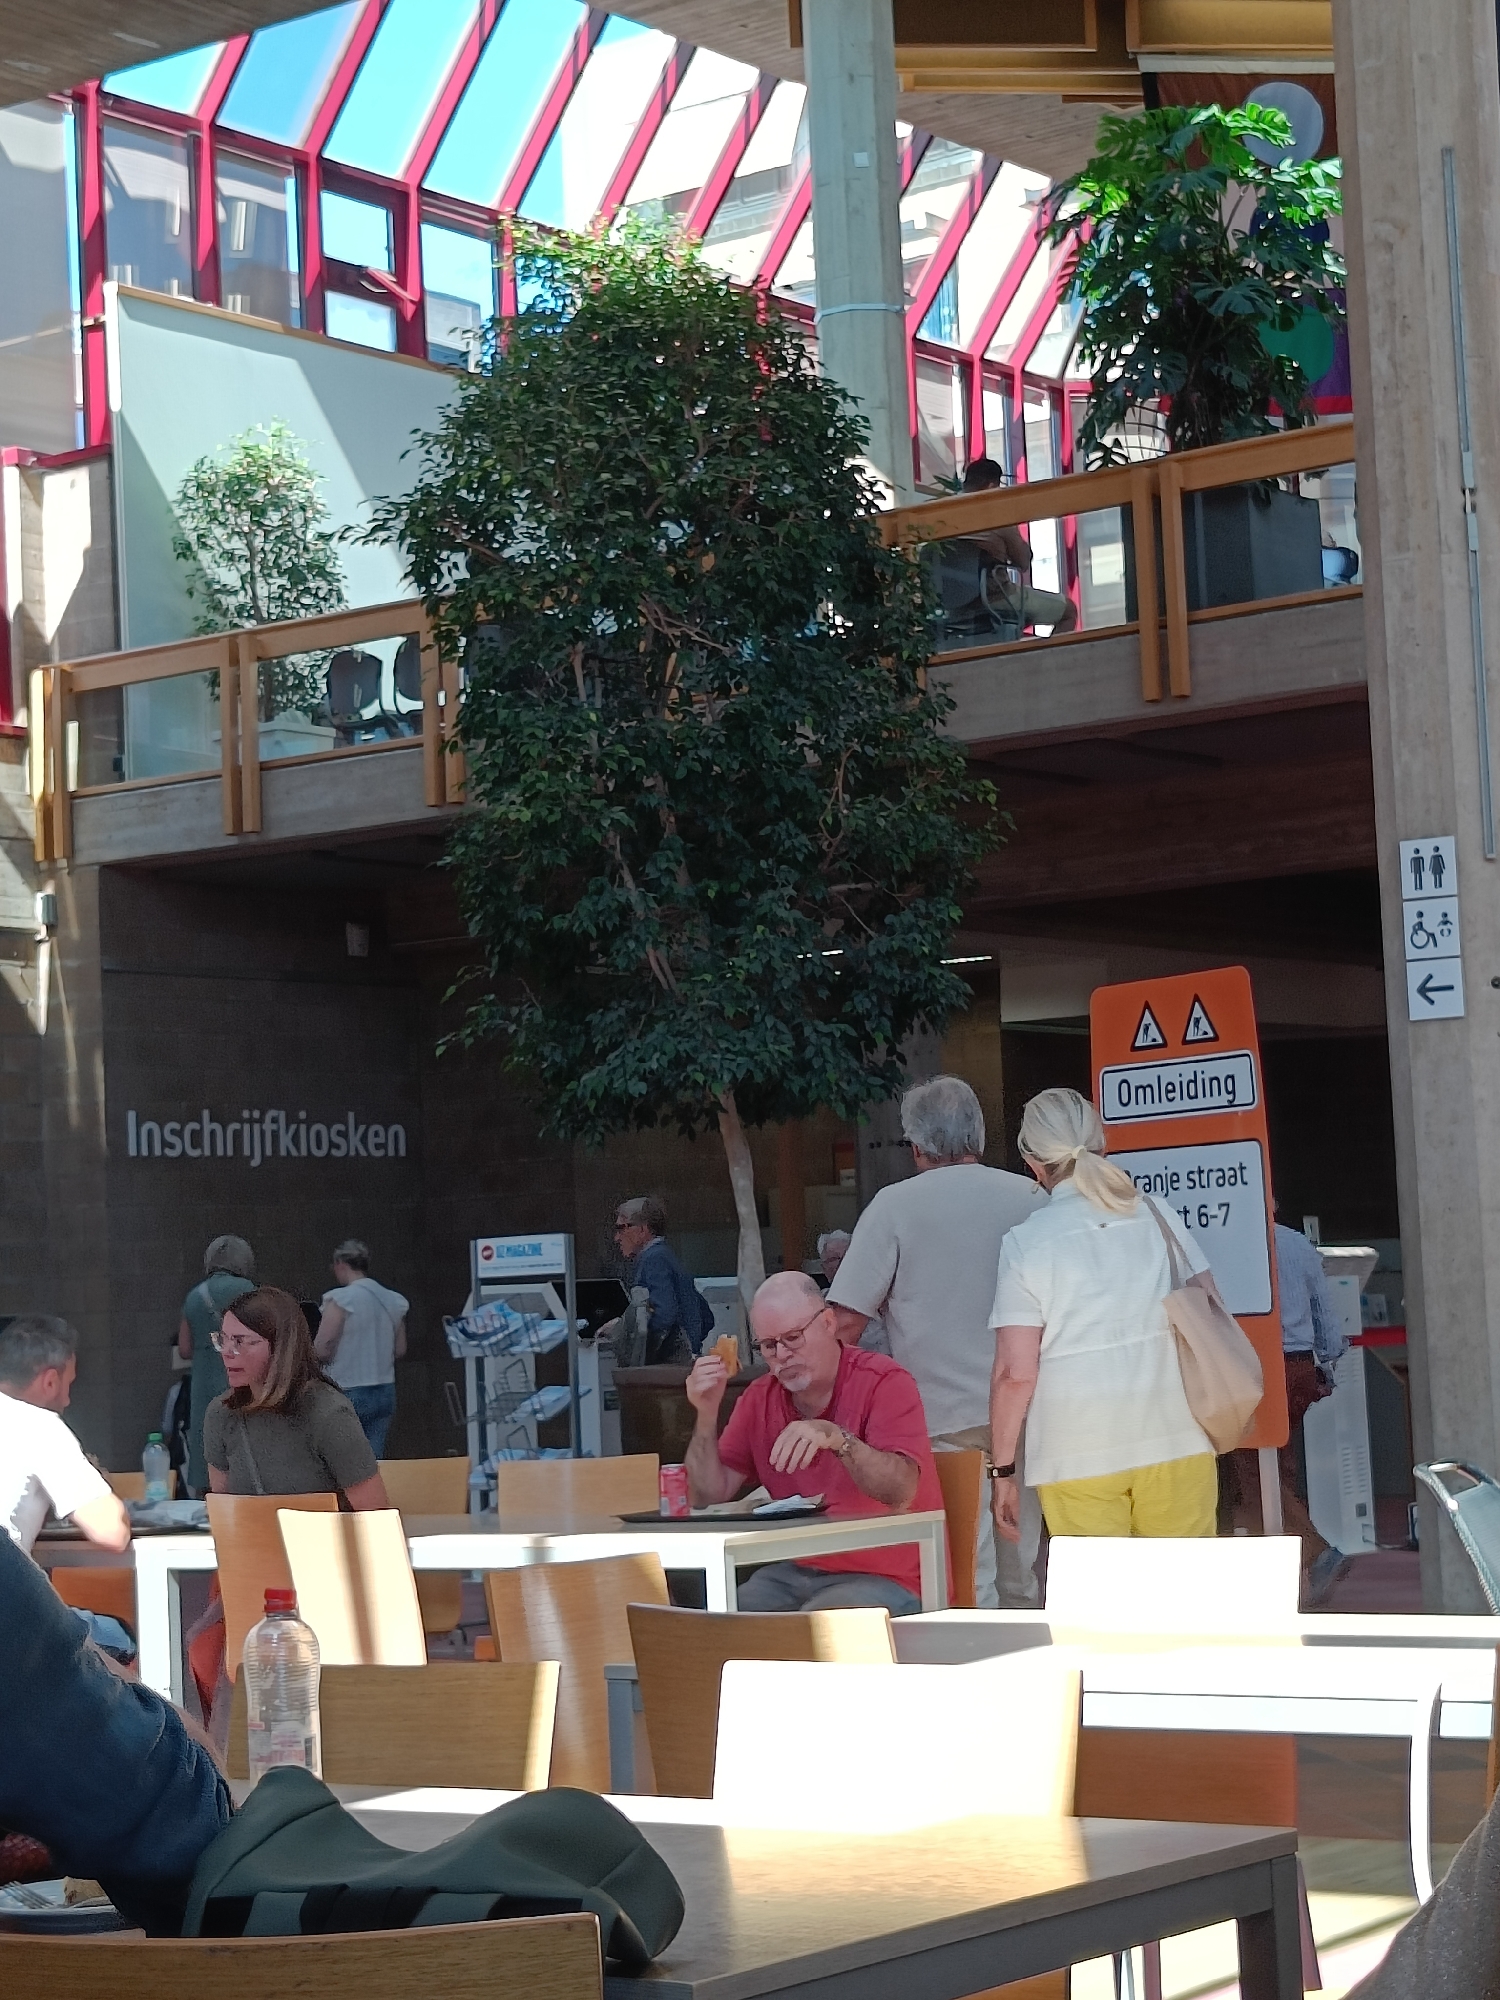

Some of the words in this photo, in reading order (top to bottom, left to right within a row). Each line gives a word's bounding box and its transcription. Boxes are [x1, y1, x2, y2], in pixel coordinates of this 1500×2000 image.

[1118, 1070, 1236, 1106] Omleiding
[126, 1109, 407, 1167] Inschrijfkiosken
[1124, 1166, 1180, 1197] ranje
[1187, 1162, 1248, 1190] straat
[1197, 1202, 1230, 1228] 6-7
